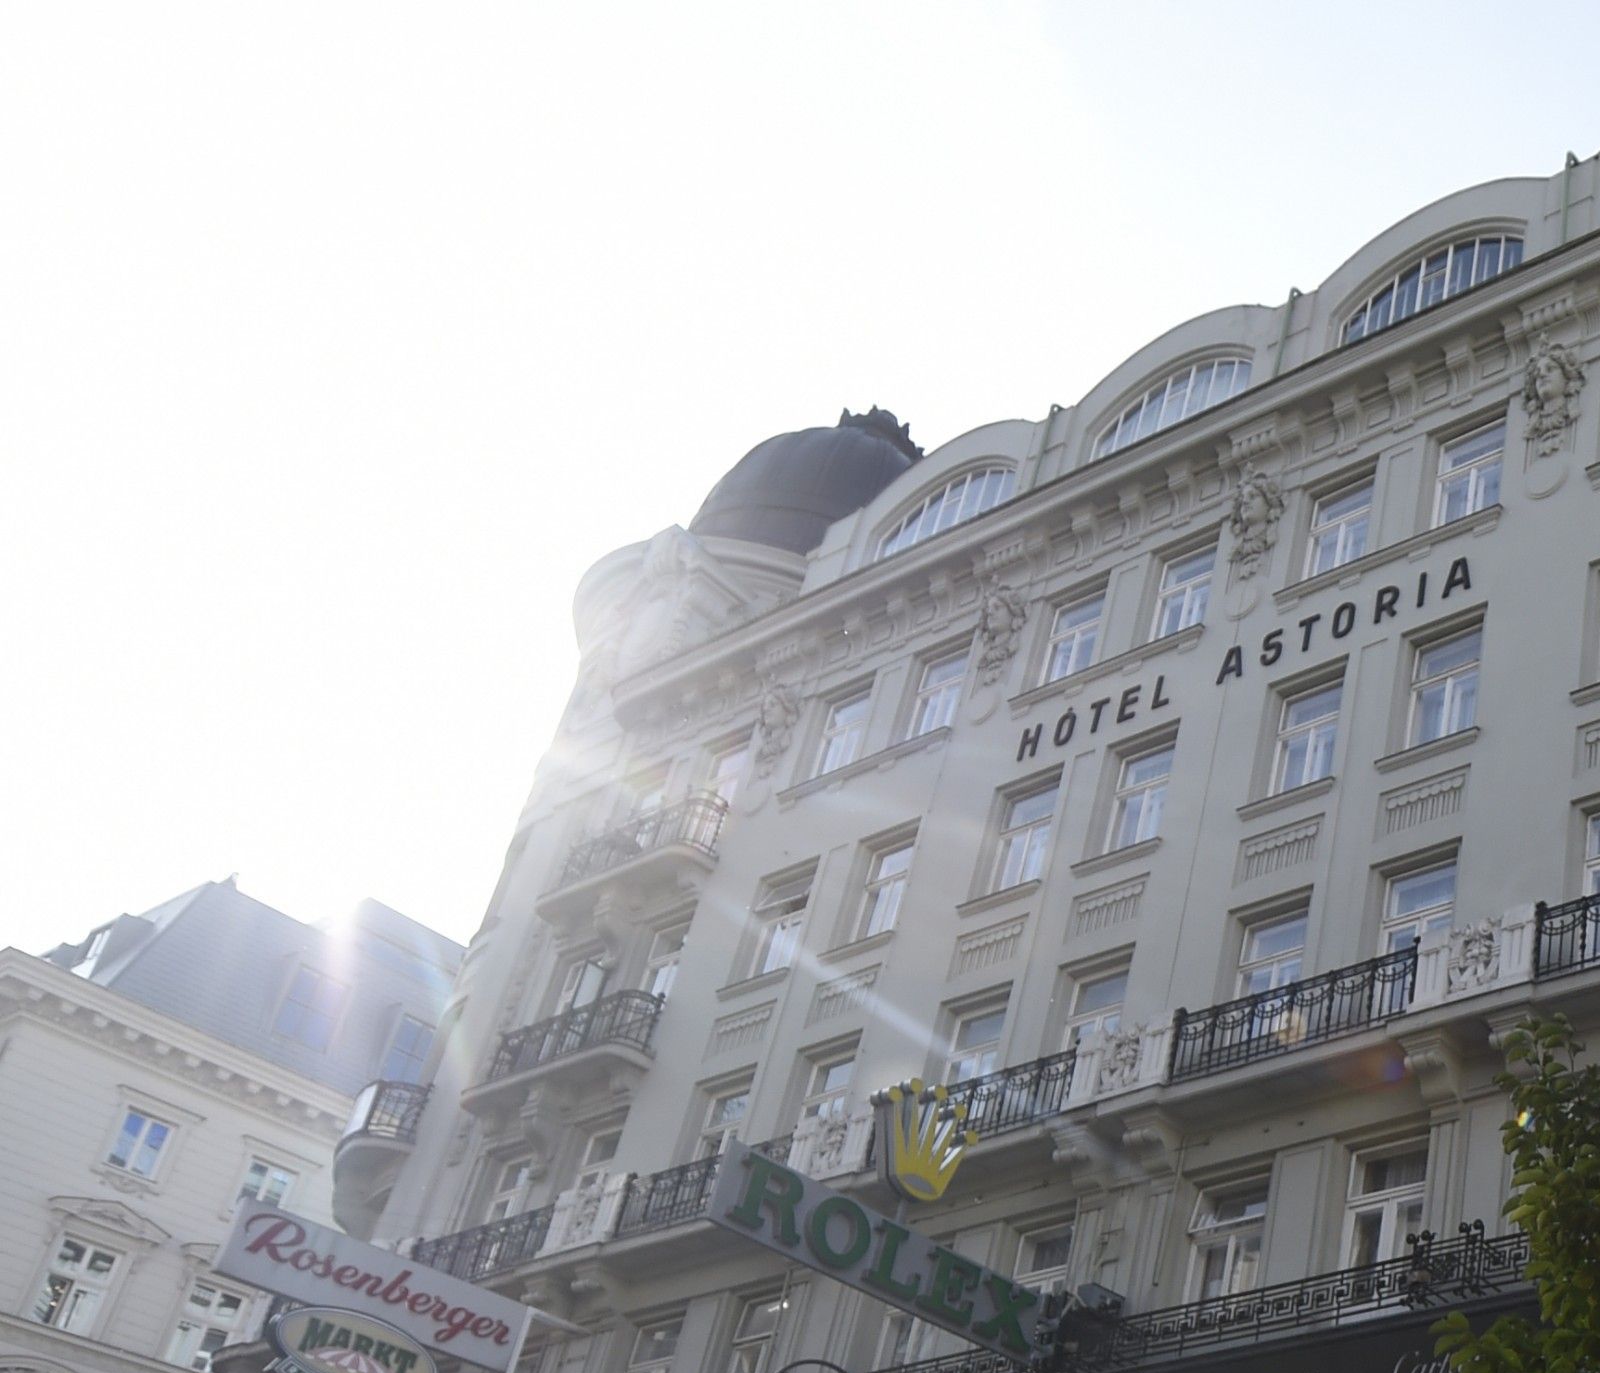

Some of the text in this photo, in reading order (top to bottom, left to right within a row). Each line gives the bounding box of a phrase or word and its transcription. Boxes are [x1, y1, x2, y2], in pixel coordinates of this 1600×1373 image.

[1215, 555, 1473, 686] ASTORIA
[244, 1212, 510, 1346] Rosenberger
[725, 1153, 1038, 1351] ROLEX
